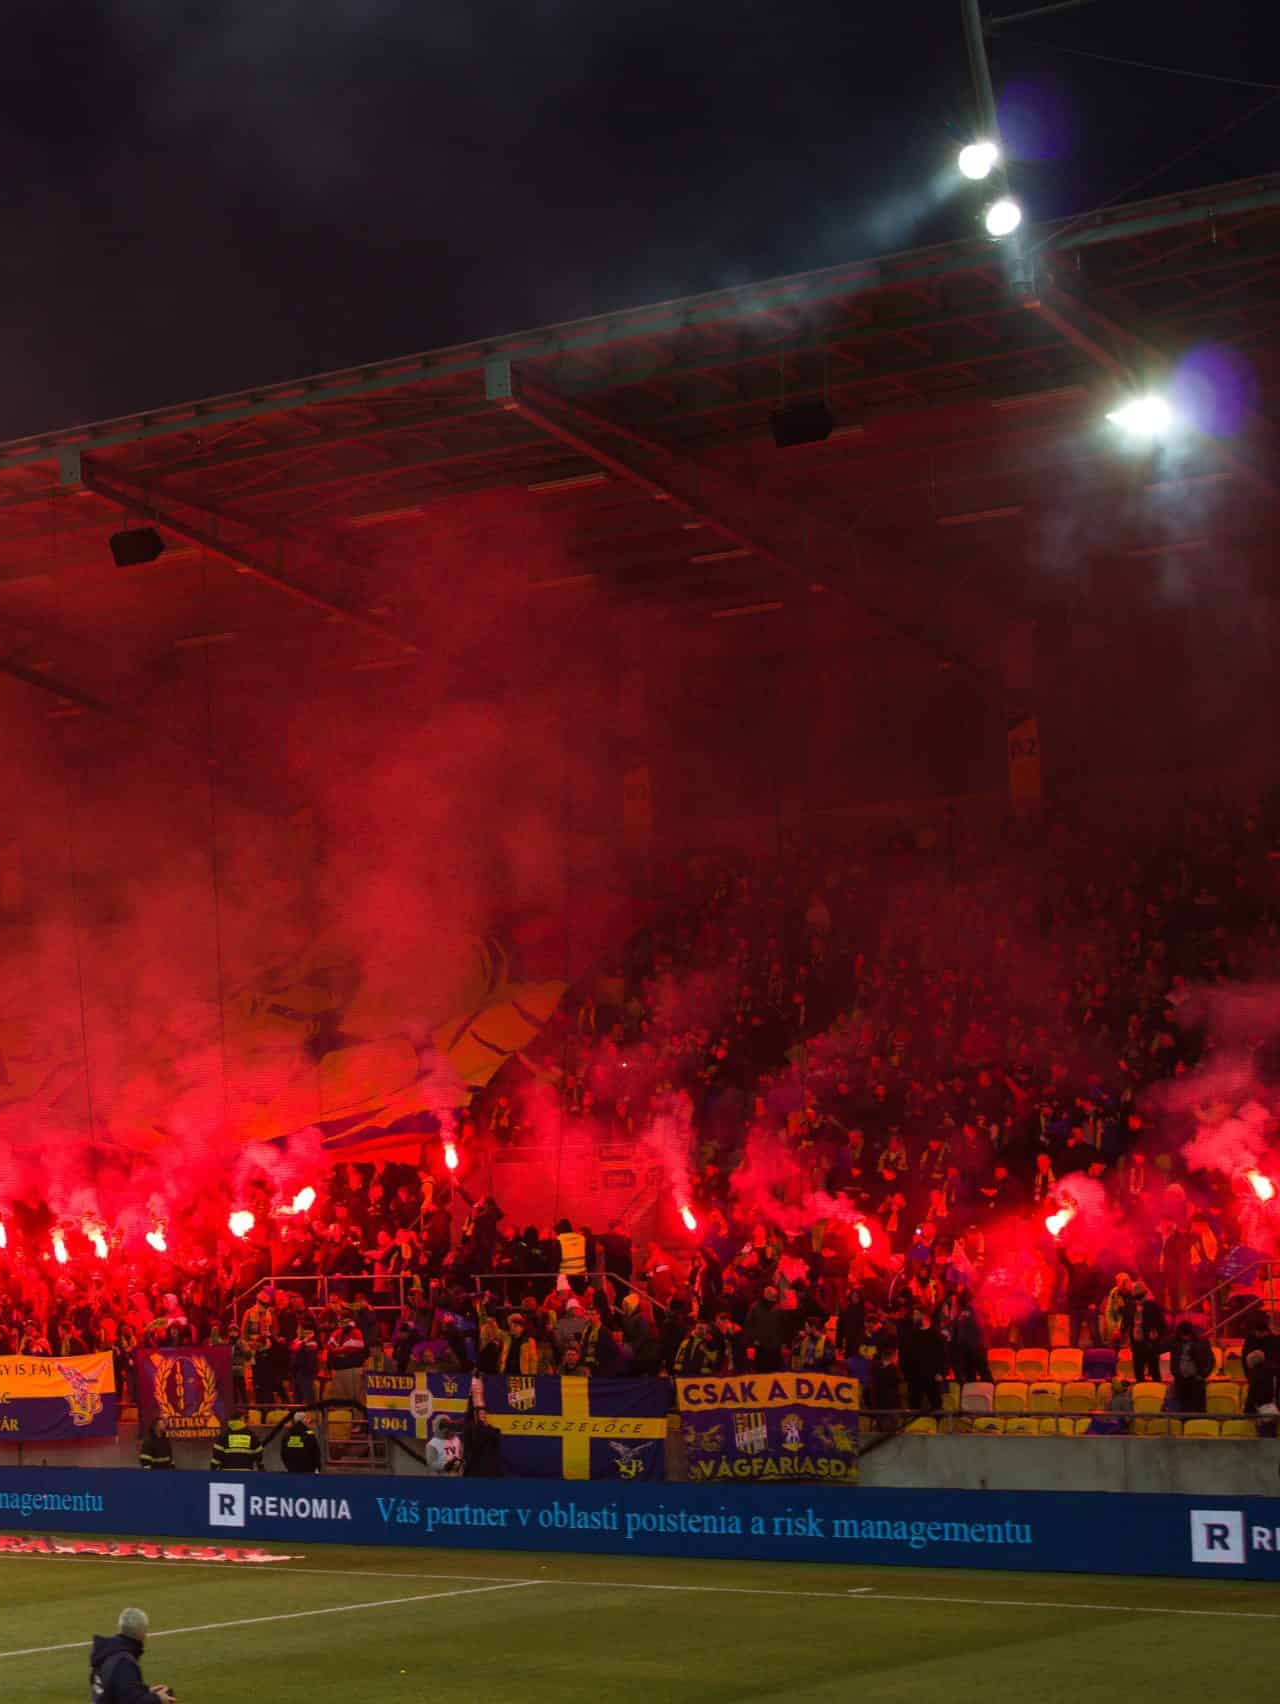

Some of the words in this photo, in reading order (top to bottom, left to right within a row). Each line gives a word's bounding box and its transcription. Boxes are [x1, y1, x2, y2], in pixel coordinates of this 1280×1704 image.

[14, 1363, 26, 1376] IS
[367, 1375, 414, 1390] NEGYED
[683, 1381, 758, 1405] CSAK
[767, 1379, 789, 1401] A
[796, 1377, 853, 1403] DAC
[373, 1416, 409, 1432] 1904
[249, 1496, 352, 1520] RENOMIA
[376, 1497, 420, 1524] Váš
[426, 1503, 509, 1532] partner
[517, 1509, 532, 1527] v
[538, 1502, 619, 1530] oblasti
[625, 1504, 742, 1540] poistenia
[750, 1516, 766, 1535] a
[771, 1508, 825, 1537] risk
[831, 1519, 1033, 1550] managementu
